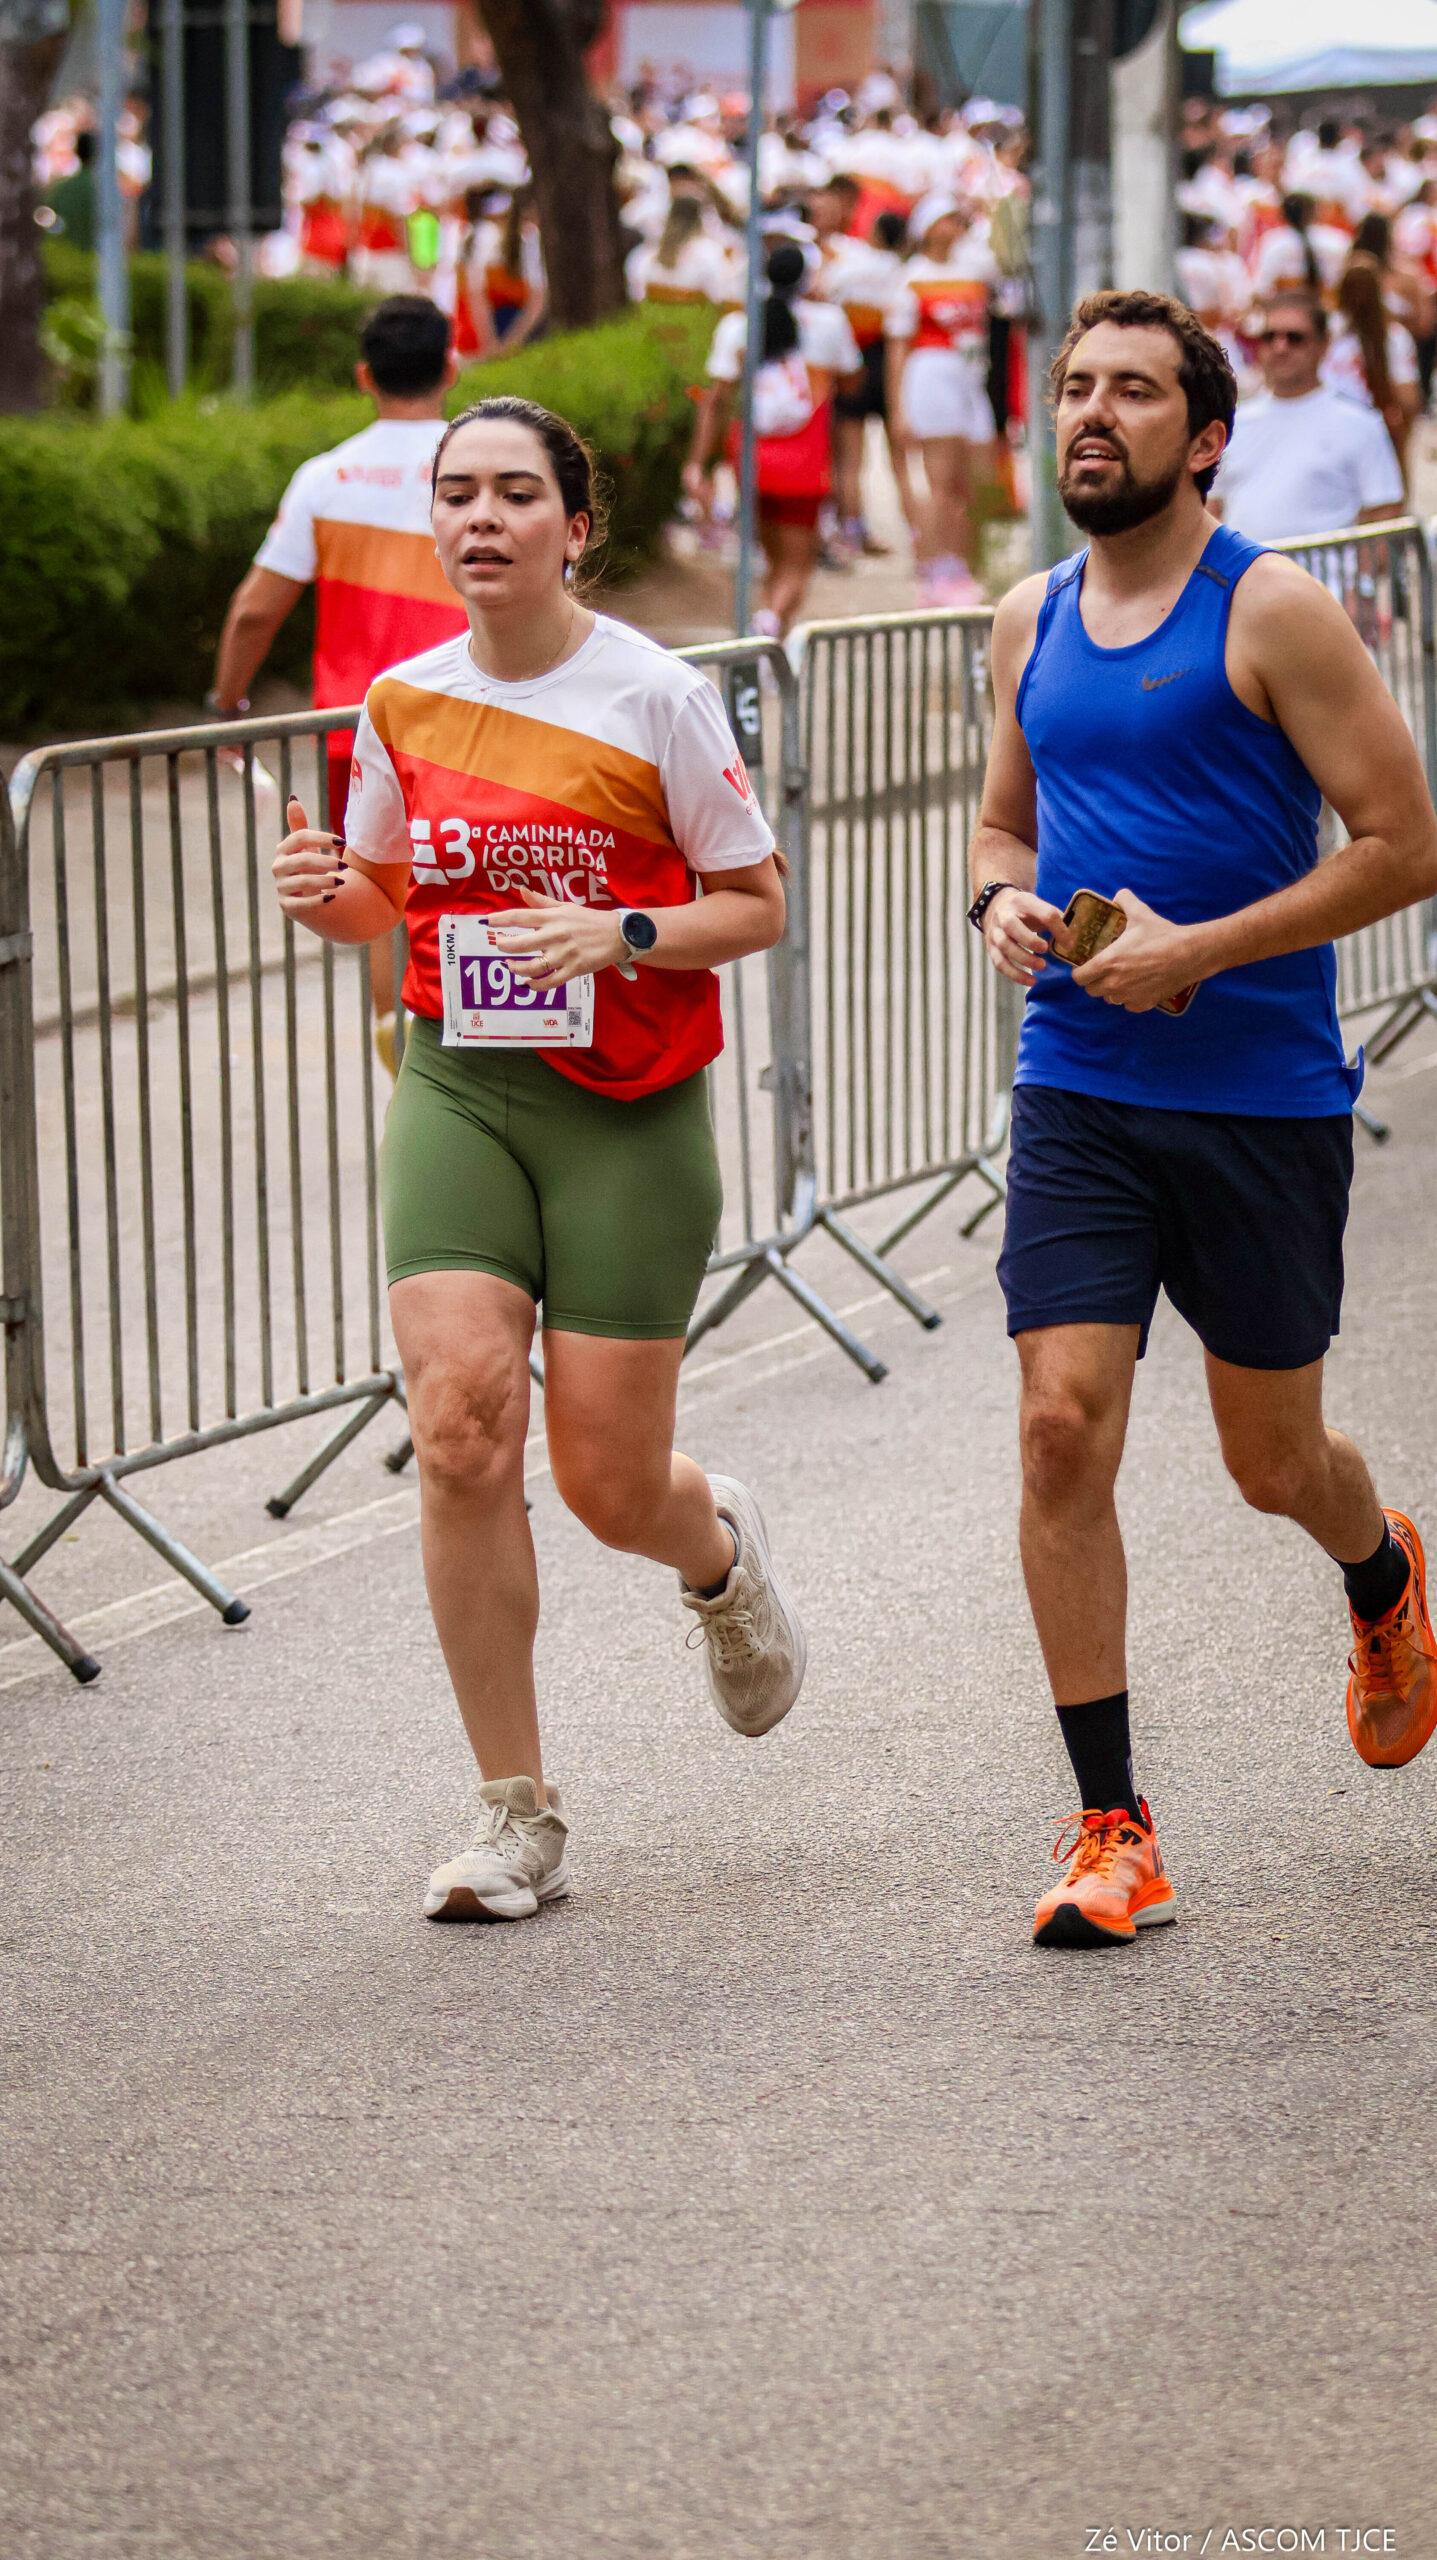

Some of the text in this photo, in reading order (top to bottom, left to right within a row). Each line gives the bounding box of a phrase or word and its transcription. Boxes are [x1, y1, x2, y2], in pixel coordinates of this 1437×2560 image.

[486, 824, 615, 848] CAMINHADA
[486, 868, 613, 905] DO TJCE
[446, 933, 456, 966] 10KM
